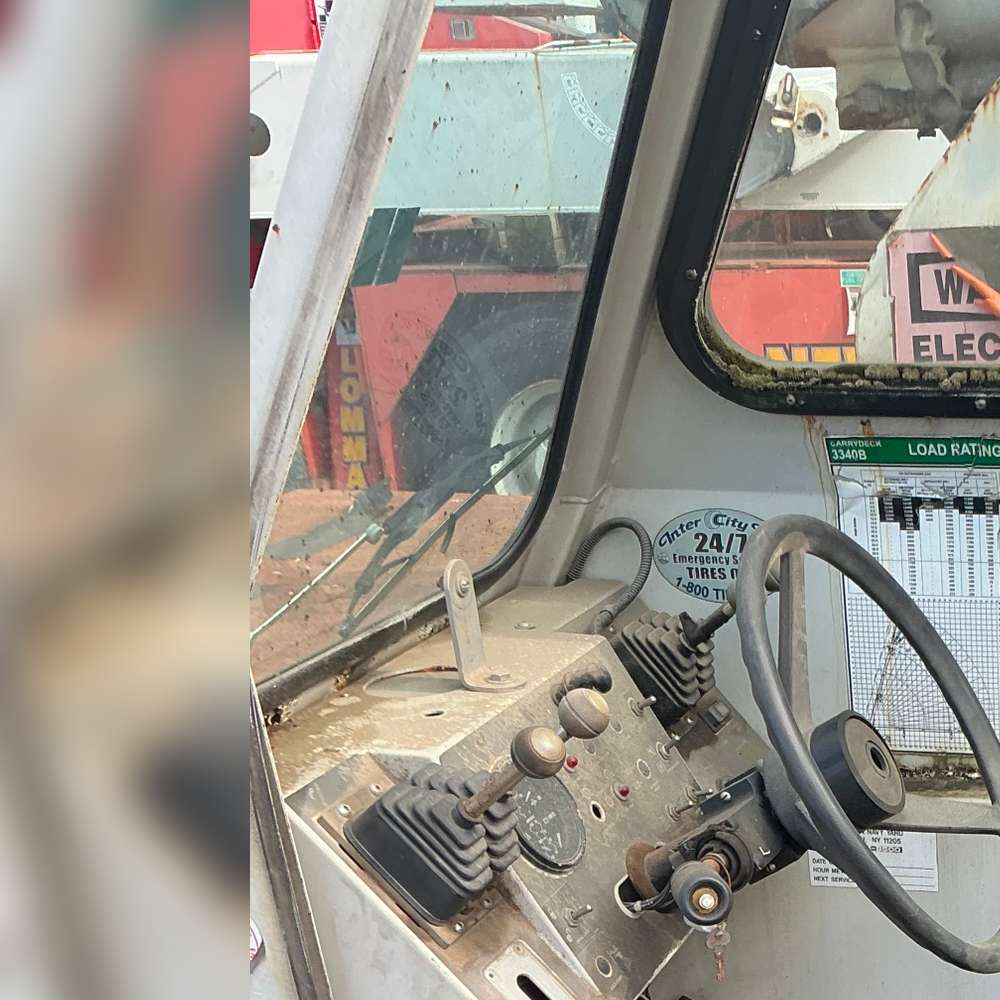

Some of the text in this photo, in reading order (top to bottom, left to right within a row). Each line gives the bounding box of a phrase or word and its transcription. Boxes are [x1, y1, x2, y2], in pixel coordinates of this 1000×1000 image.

[831, 449, 868, 461] 3340B
[908, 442, 947, 457] LOAD
[712, 513, 749, 532] City
[694, 532, 747, 554] 24/7
[672, 554, 730, 565] Emergency
[686, 566, 727, 580] TIRES
[675, 577, 710, 598] 1-800
